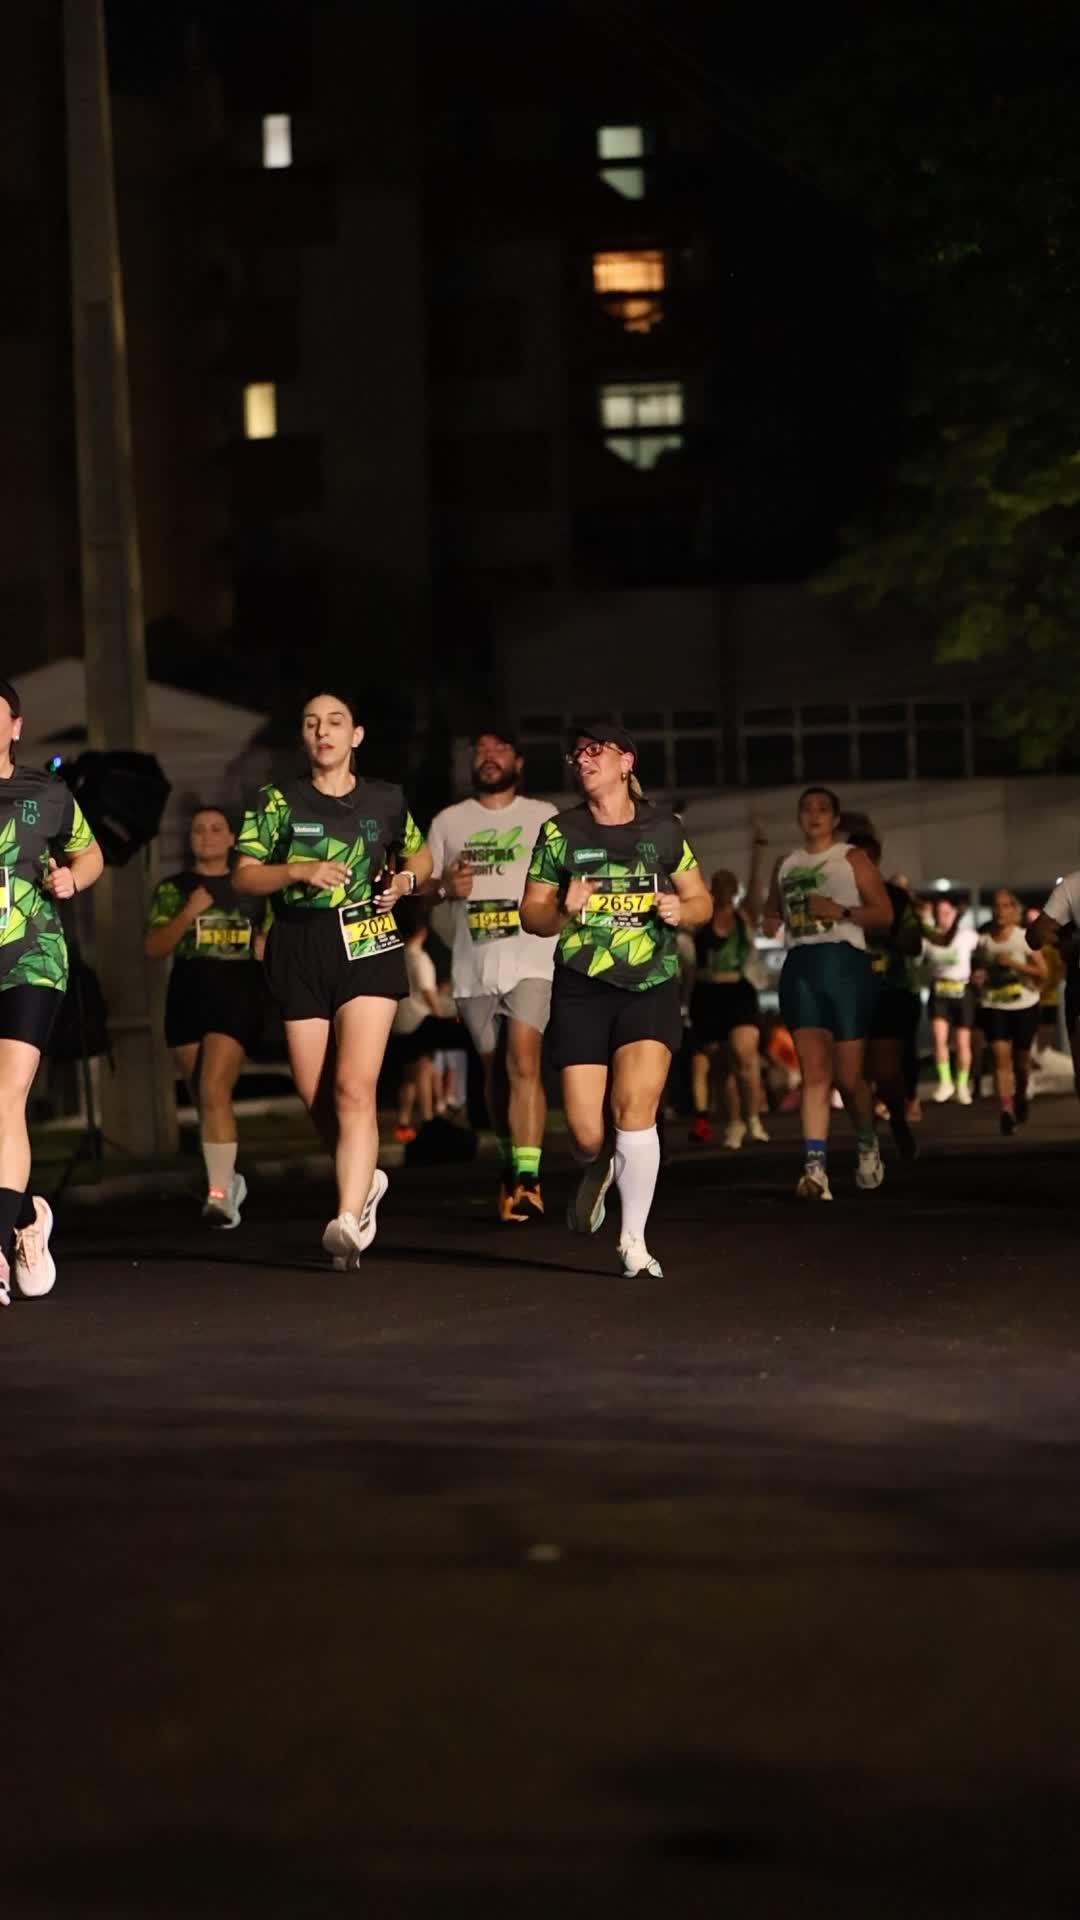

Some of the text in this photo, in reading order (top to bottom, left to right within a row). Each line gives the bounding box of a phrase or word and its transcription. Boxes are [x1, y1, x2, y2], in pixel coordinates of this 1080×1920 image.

[598, 895, 645, 912] 2657
[357, 914, 393, 939] 2021
[474, 911, 511, 928] 1944
